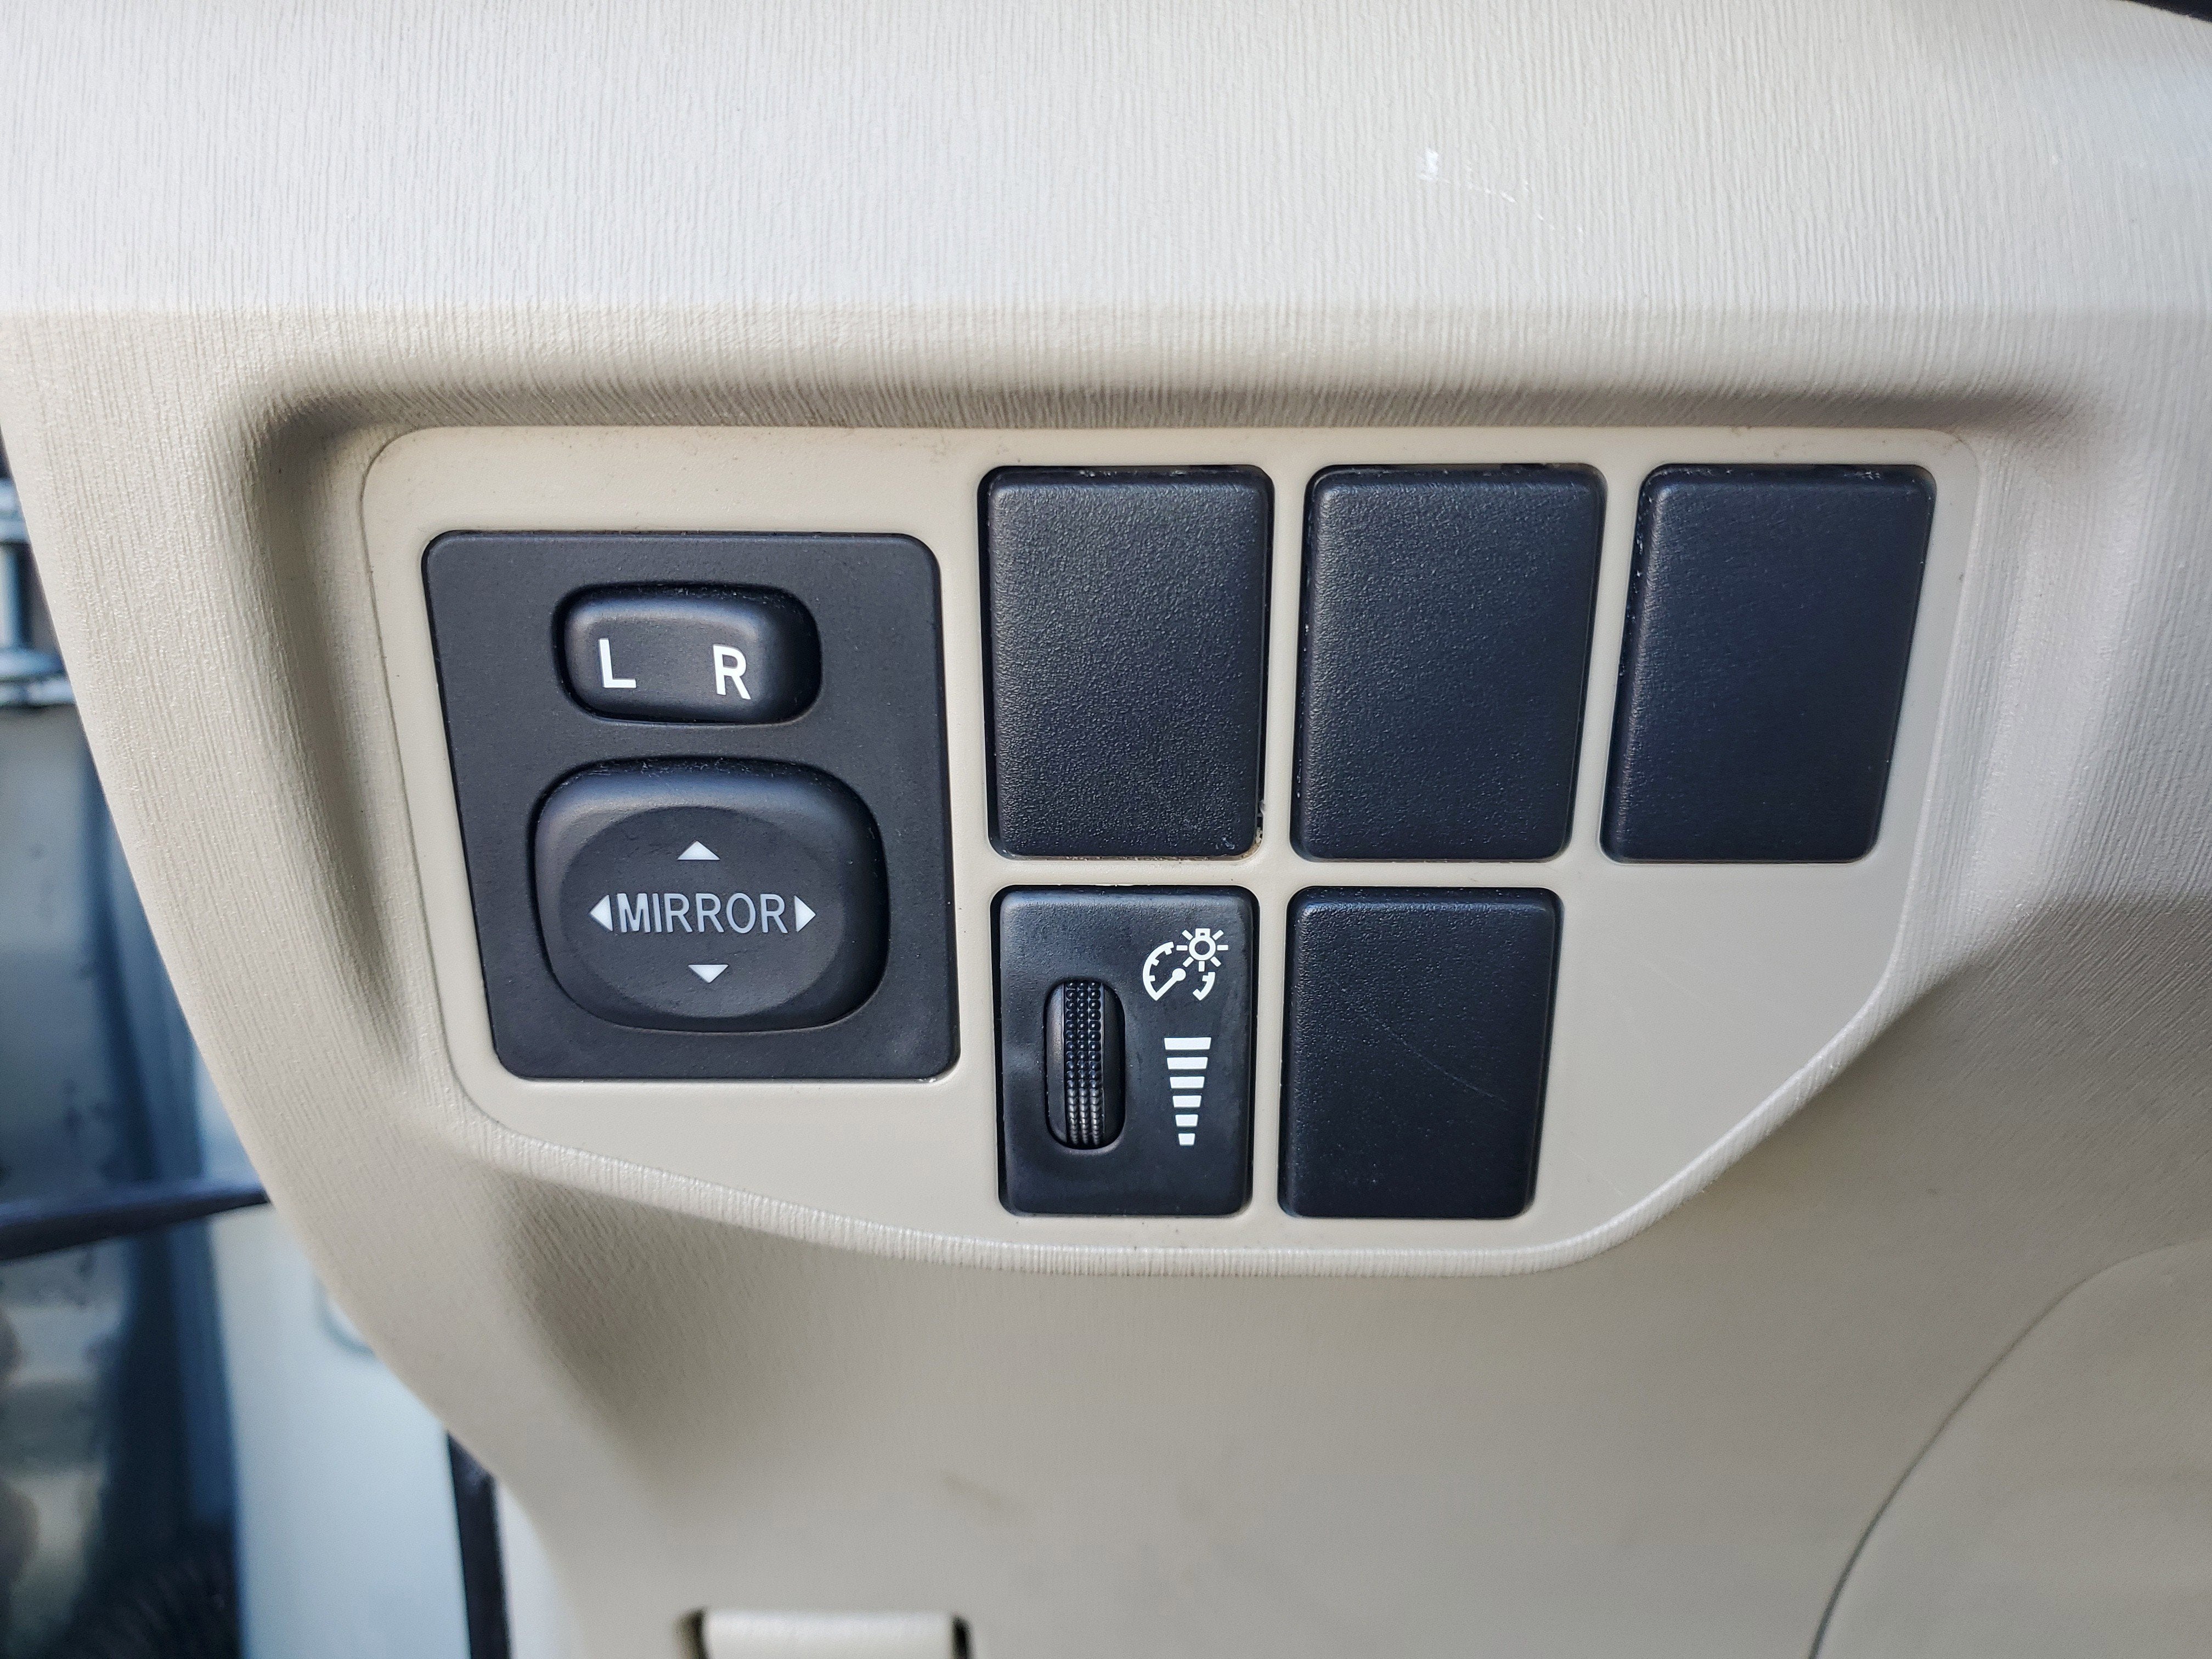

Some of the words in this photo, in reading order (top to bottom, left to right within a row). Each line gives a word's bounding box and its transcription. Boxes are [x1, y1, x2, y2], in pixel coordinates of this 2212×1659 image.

[597, 637, 637, 689] L
[712, 644, 752, 700] R
[617, 893, 788, 934] MIRROR
